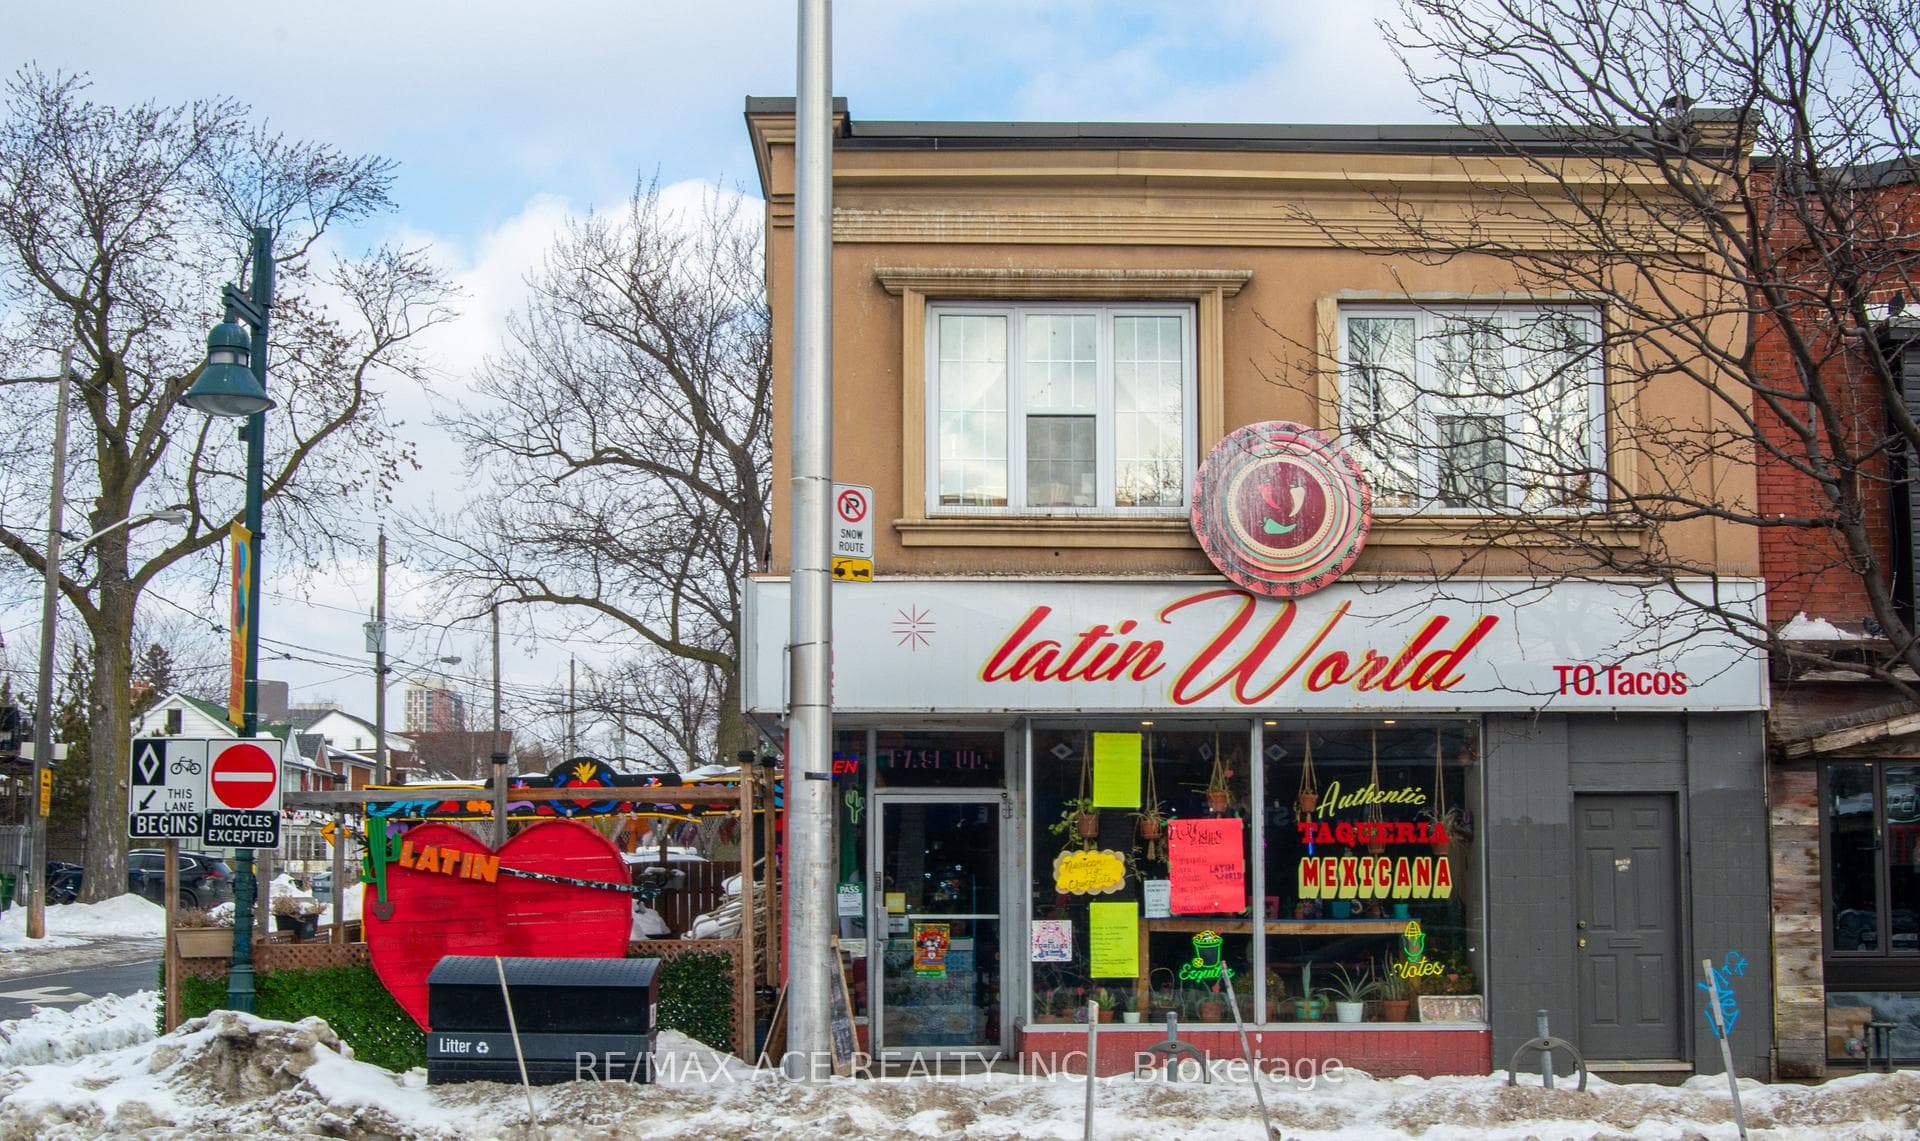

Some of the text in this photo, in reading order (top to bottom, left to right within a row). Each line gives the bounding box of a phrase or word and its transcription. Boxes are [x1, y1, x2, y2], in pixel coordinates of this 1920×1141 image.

[841, 529, 863, 540] SNOW
[839, 541, 865, 553] ROUTE
[1156, 588, 1500, 706] World
[1552, 664, 1688, 696] TO.Tacos
[832, 760, 858, 774] EN
[168, 788, 192, 799] THIS
[1317, 781, 1427, 819] Authentic
[164, 802, 194, 812] LANE
[136, 815, 198, 834] BEGINS
[212, 814, 272, 827] BICYCLES
[208, 830, 274, 844] EXCEPTED
[1297, 821, 1451, 848] TAQUERIA
[399, 840, 501, 883] LATIN
[1298, 856, 1453, 899] MEXICANA
[839, 885, 860, 894] PASS
[439, 1038, 472, 1053] Litter
